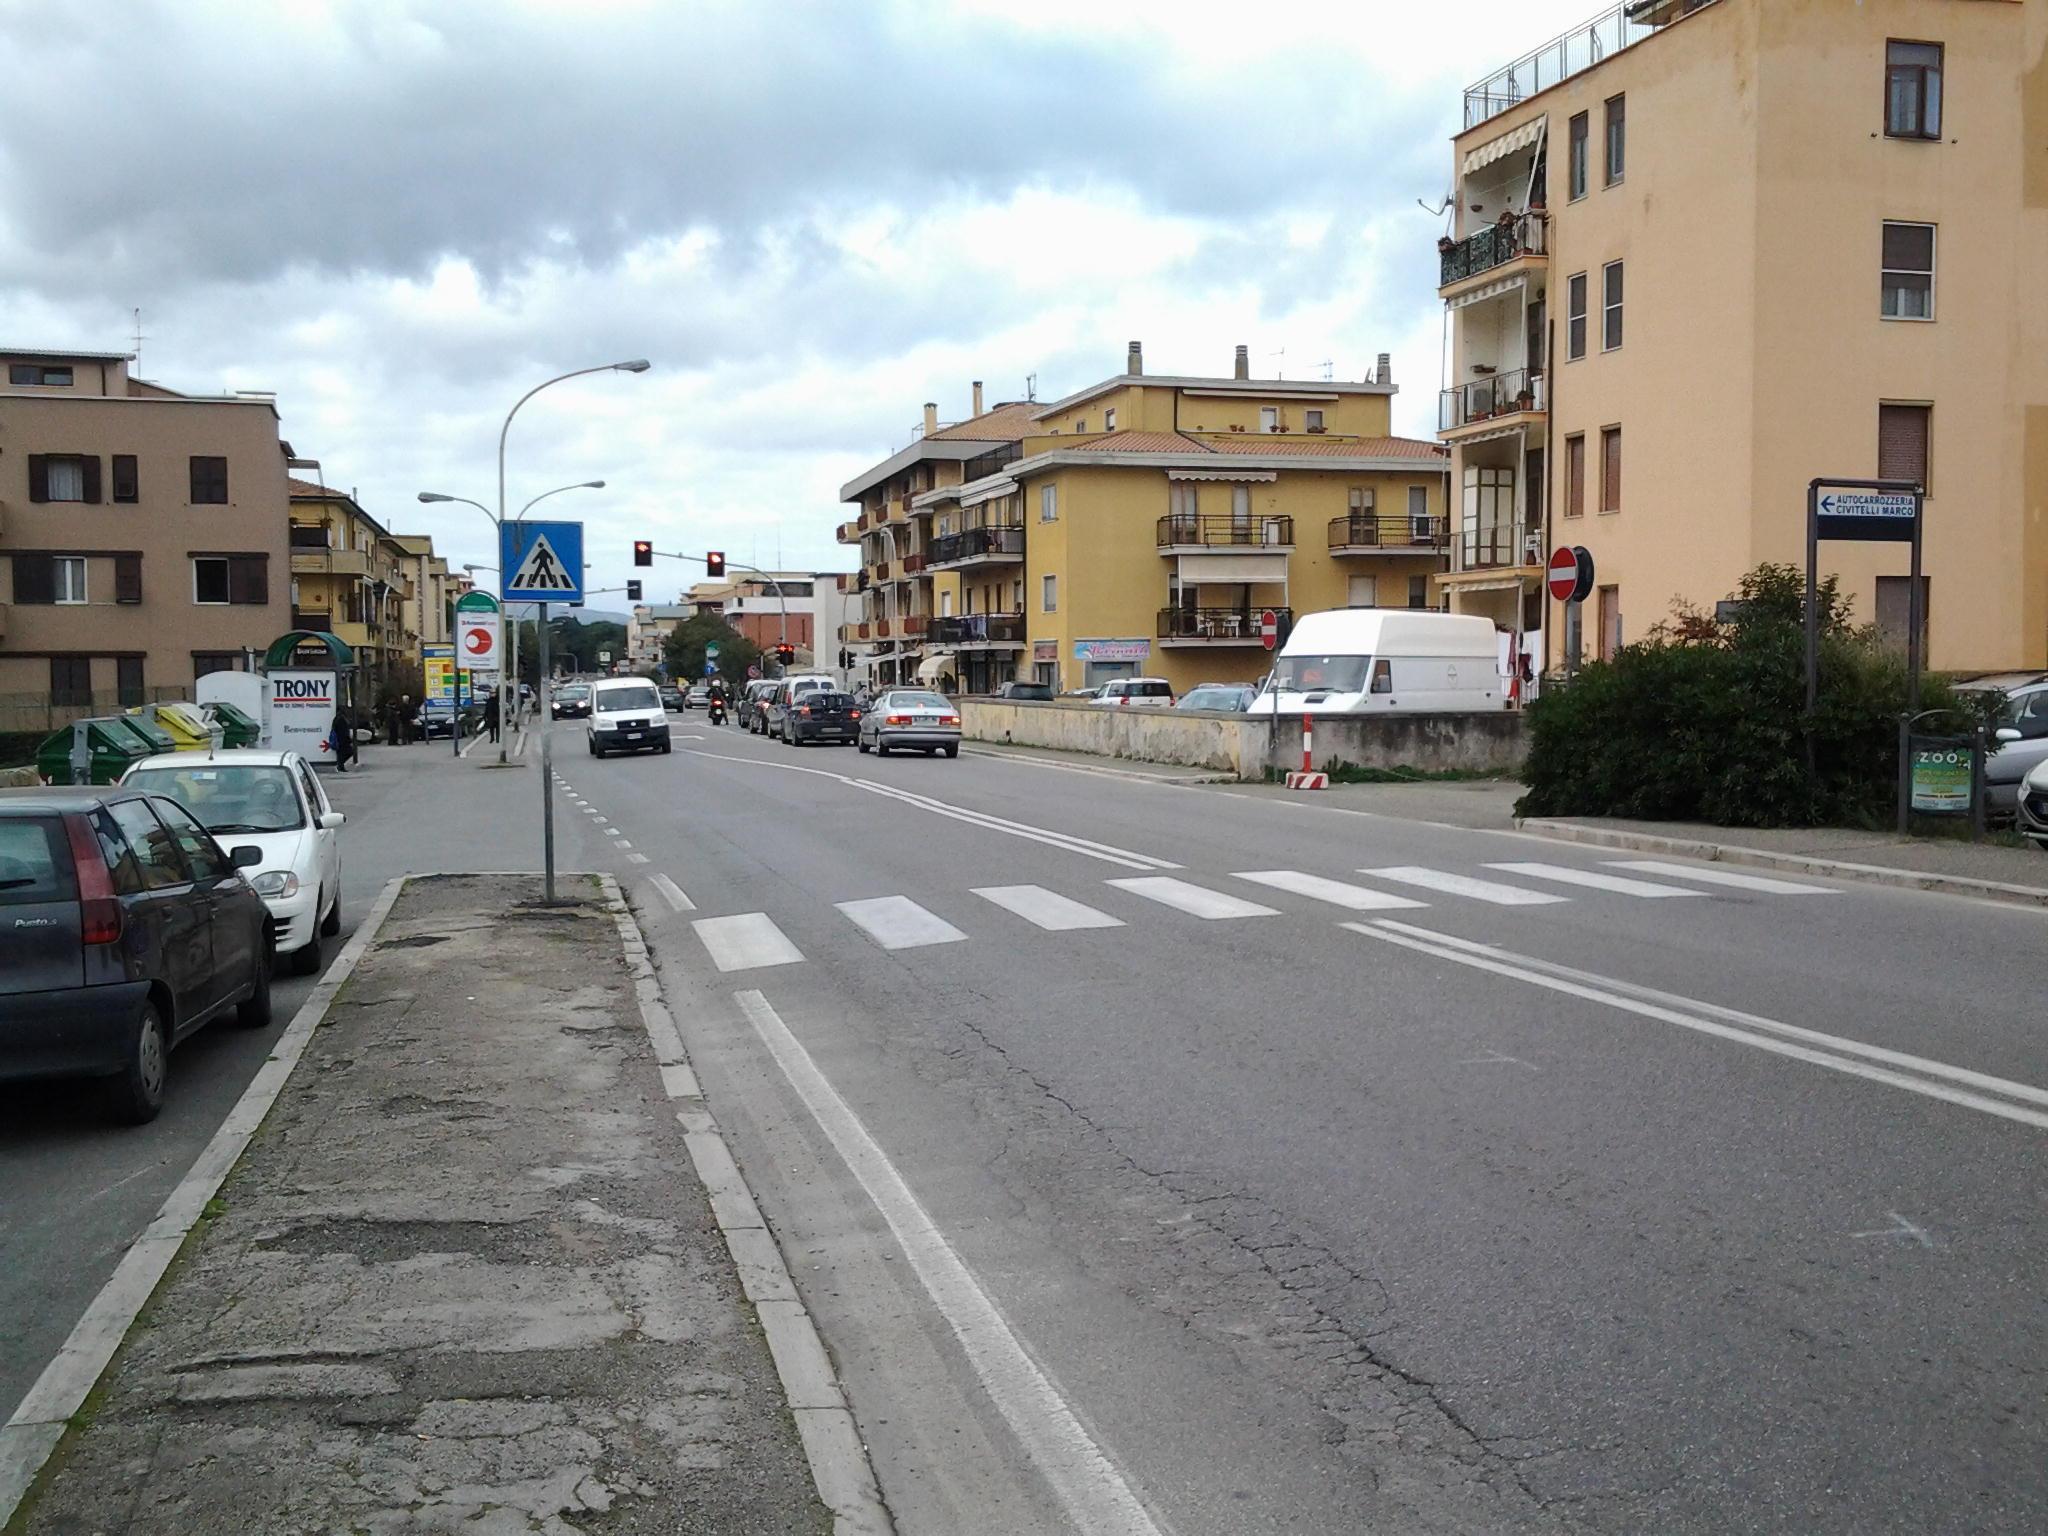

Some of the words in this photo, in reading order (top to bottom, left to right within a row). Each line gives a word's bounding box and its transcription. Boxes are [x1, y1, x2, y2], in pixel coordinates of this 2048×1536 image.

[1836, 495, 1914, 506] AUTOCARROZZERIA
[1836, 505, 1880, 515] CIVITELLI
[1882, 506, 1914, 516] MARCO
[274, 680, 330, 697] TRONY
[1919, 751, 1958, 764] ZOO
